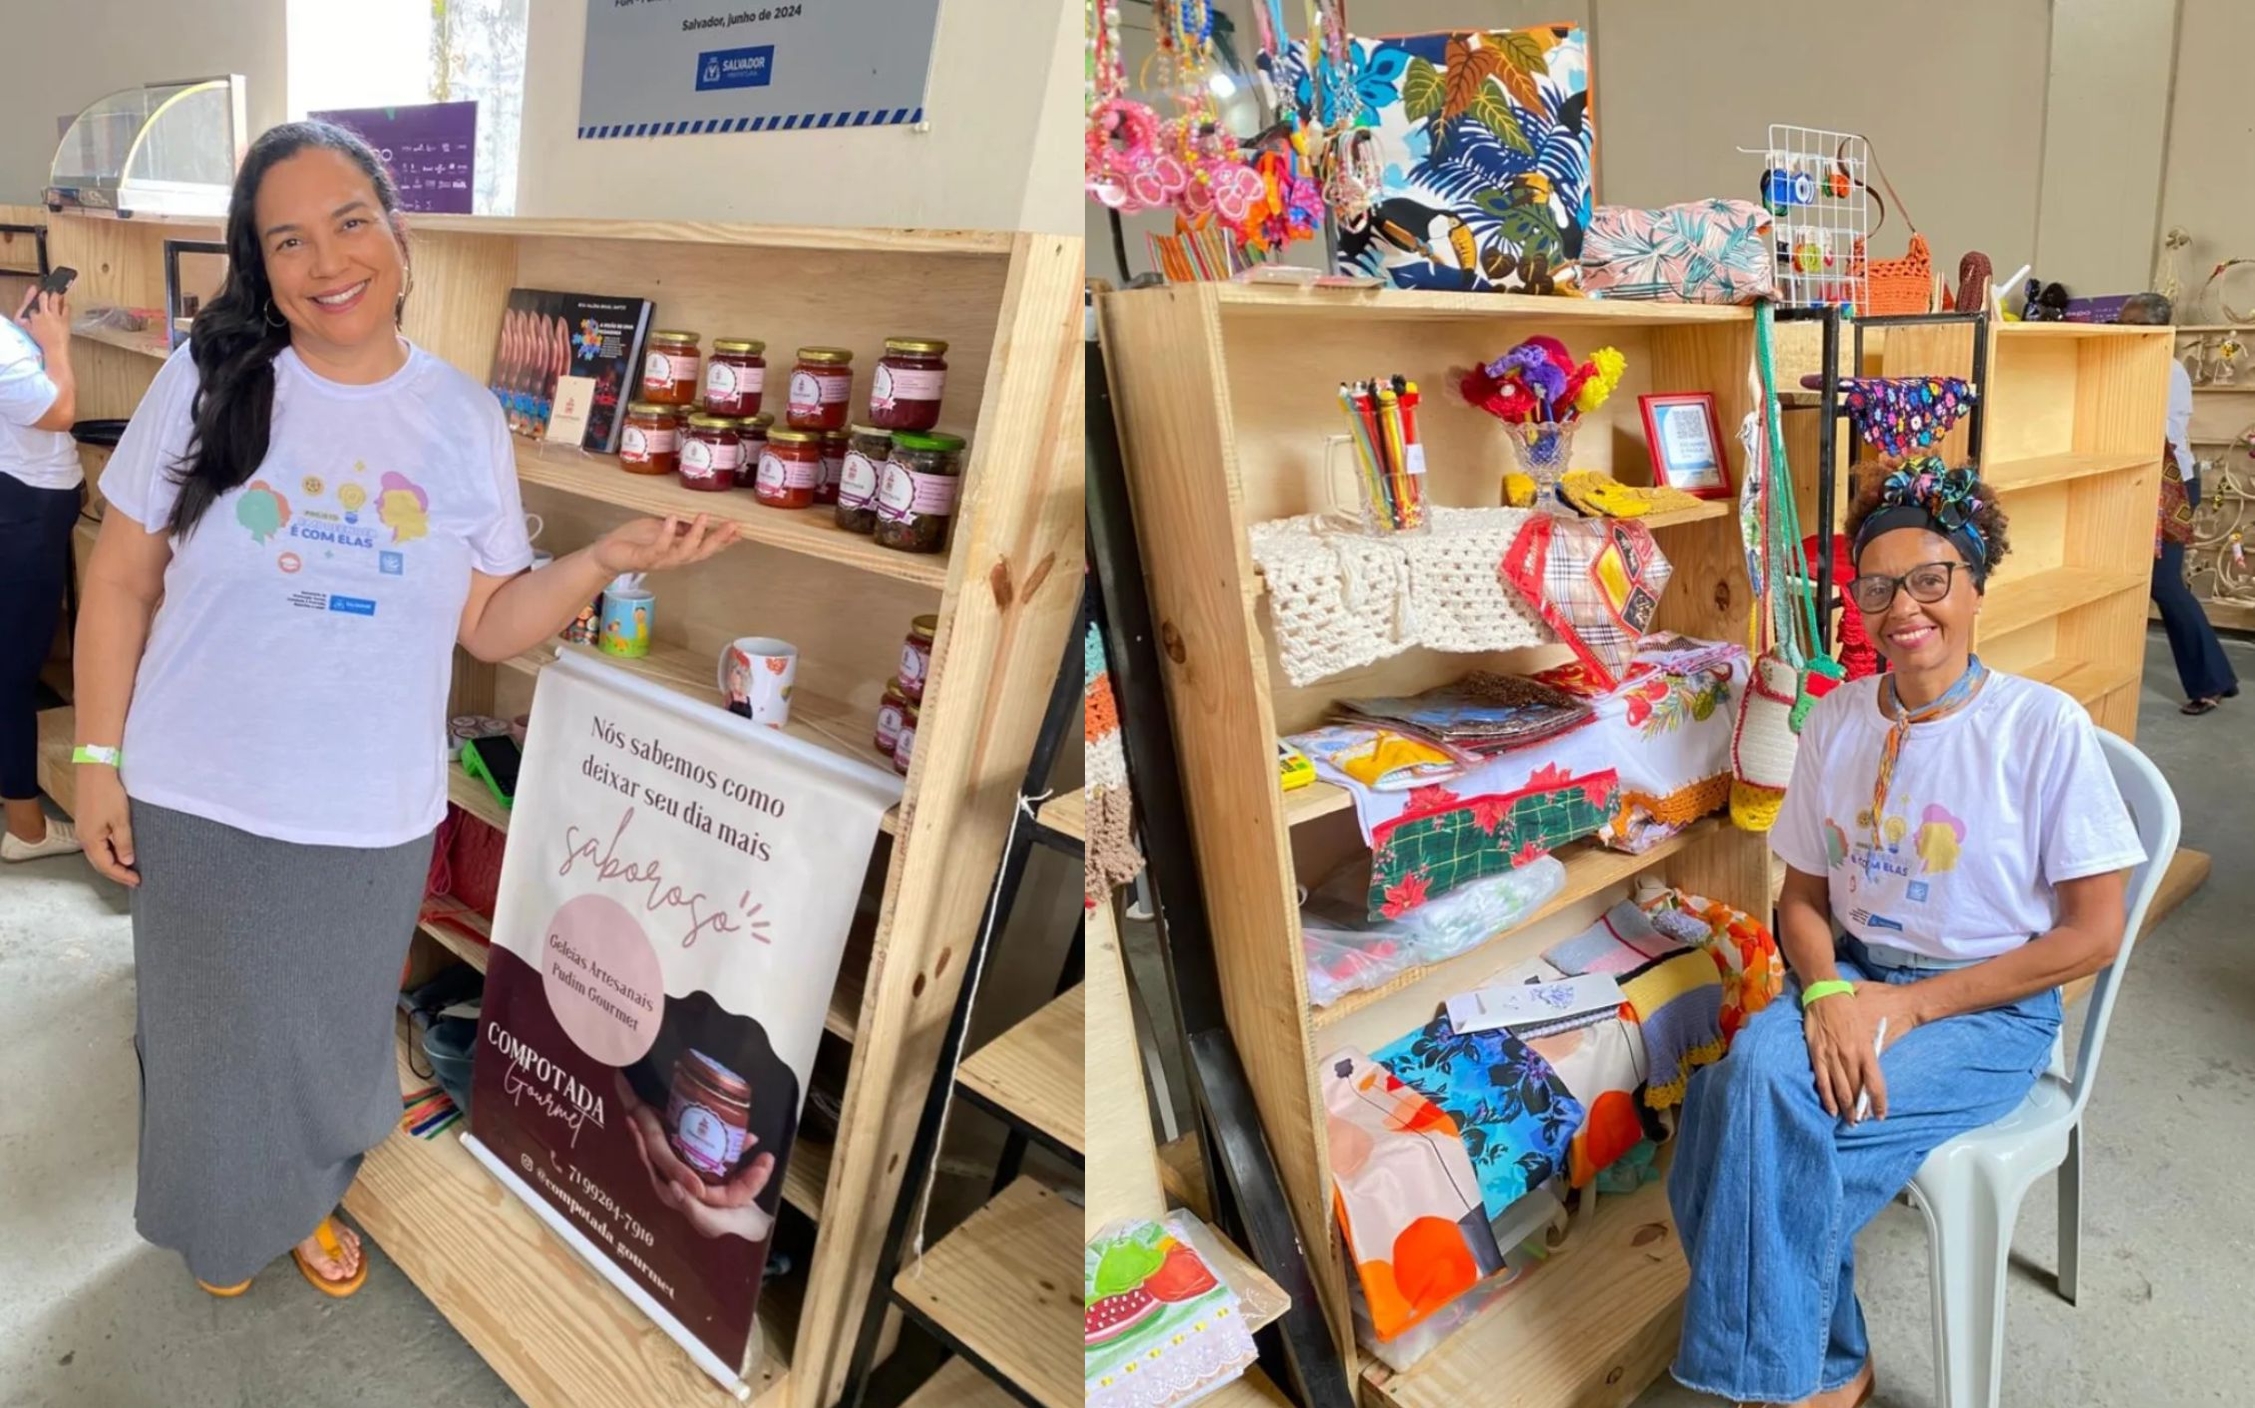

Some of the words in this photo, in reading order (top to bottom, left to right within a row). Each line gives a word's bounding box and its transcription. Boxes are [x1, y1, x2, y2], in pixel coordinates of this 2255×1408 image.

[682, 16, 725, 32] Salvador,
[727, 12, 756, 27] junho
[758, 8, 771, 21] de
[774, 4, 802, 20] 2024
[722, 56, 765, 72] SALVADOR
[290, 523, 299, 537] É
[302, 528, 335, 543] COM
[338, 534, 373, 548] ELAS
[591, 715, 626, 750] Nós
[630, 739, 717, 790] sabemos
[722, 777, 785, 819] como
[582, 754, 640, 799] deixar
[644, 787, 678, 818] seu
[683, 804, 712, 835] dia
[718, 822, 771, 862] mais
[559, 806, 740, 948] saboroso
[1883, 862, 1908, 876] ELAS
[549, 934, 587, 970] Geleias
[589, 960, 654, 1012] Artesanais
[552, 962, 586, 996] Pudim
[588, 987, 639, 1031] Gourmet
[488, 1021, 605, 1125] COMPOTADA
[504, 1058, 604, 1149] Gourmet
[569, 1164, 582, 1184] 71
[582, 1177, 654, 1247] 99204-7910
